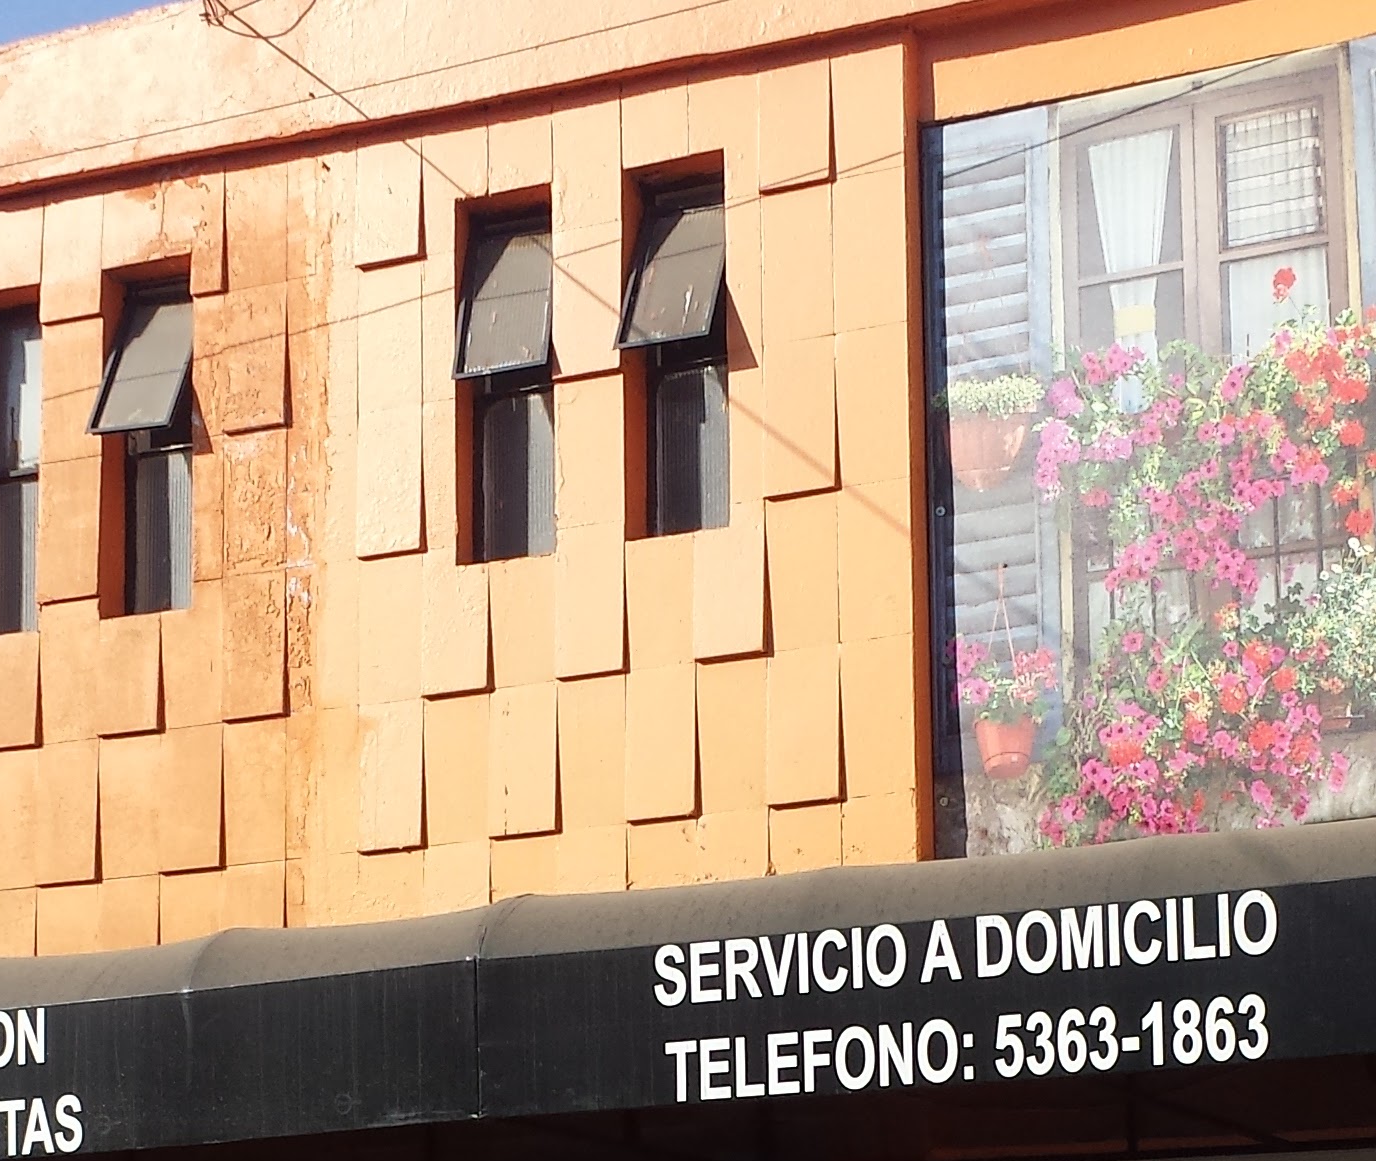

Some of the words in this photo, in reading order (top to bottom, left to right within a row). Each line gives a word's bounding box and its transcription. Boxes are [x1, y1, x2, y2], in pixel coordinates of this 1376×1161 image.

[653, 923, 906, 1007] SERVICIO
[920, 920, 963, 984] A
[975, 889, 1278, 979] DOMICILIO
[664, 1018, 976, 1103] TELEFONO:
[993, 993, 1270, 1079] 5363-1863
